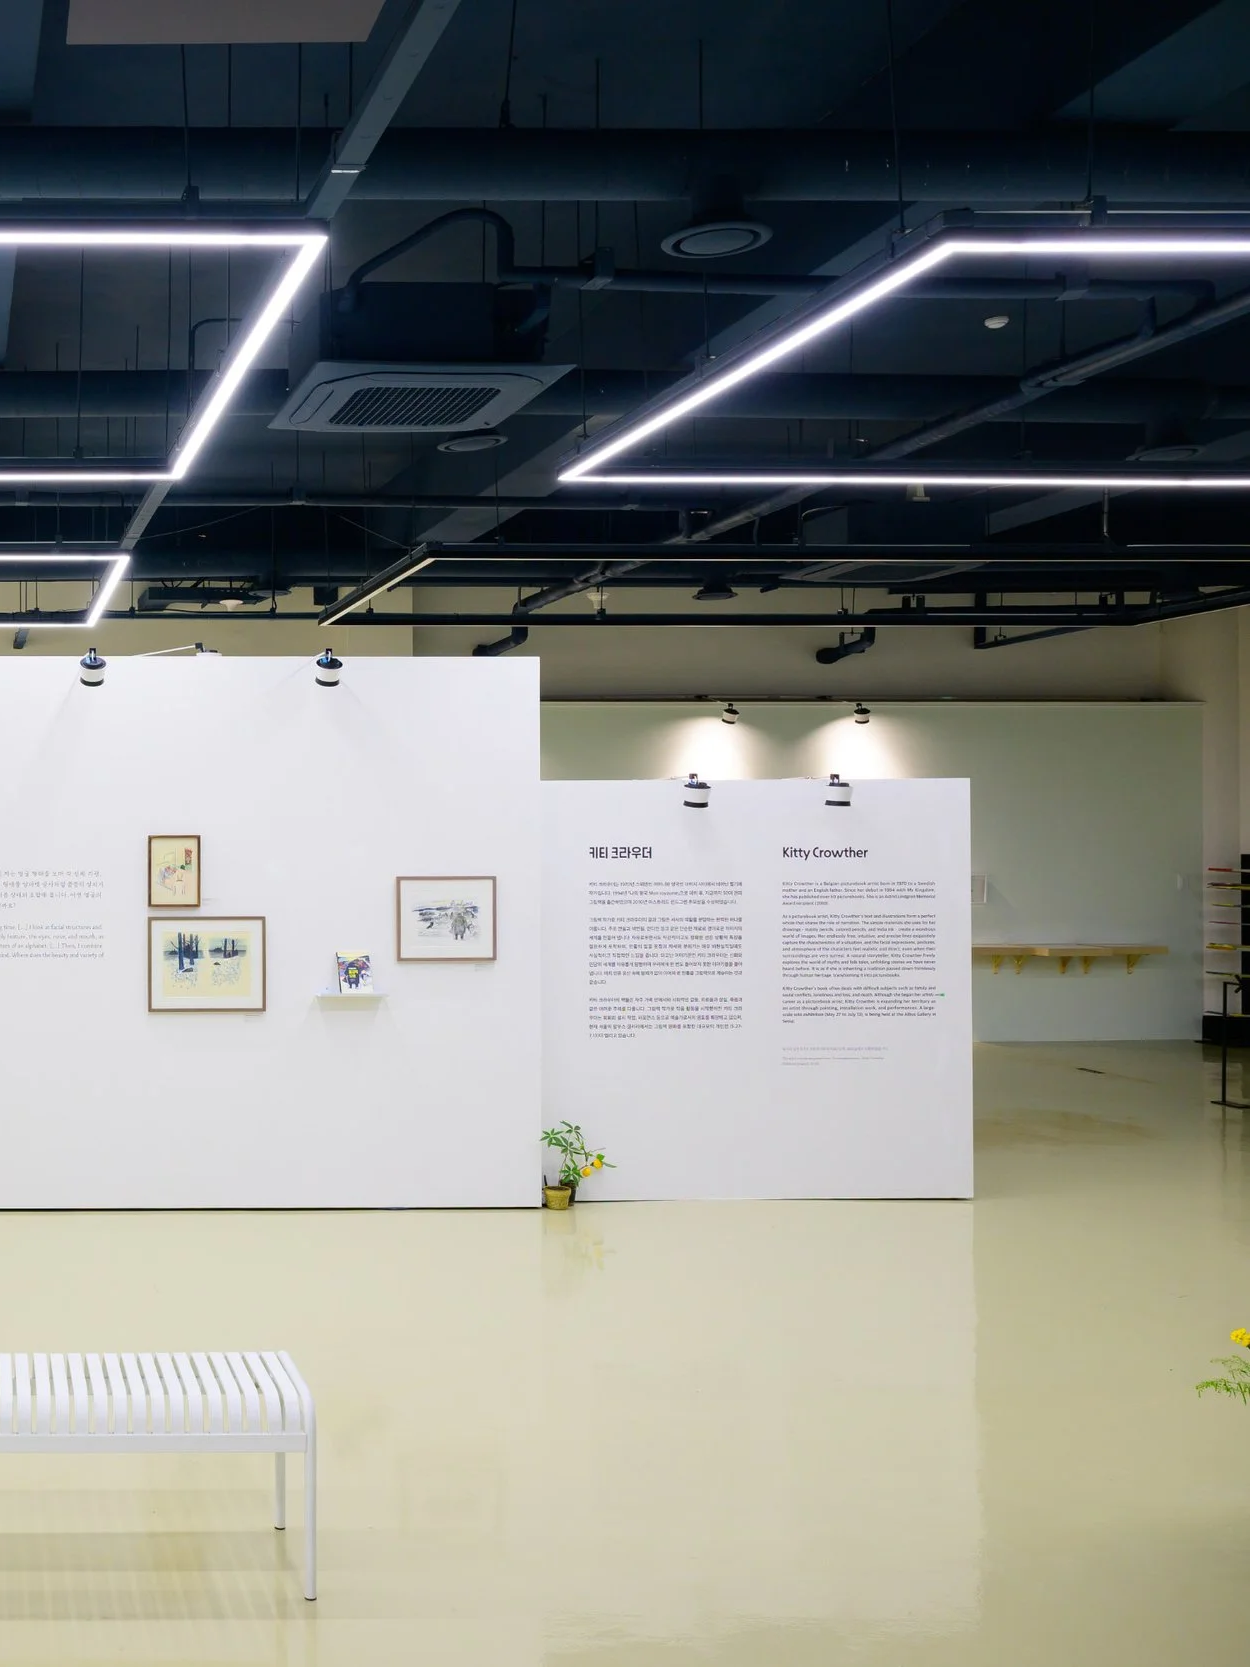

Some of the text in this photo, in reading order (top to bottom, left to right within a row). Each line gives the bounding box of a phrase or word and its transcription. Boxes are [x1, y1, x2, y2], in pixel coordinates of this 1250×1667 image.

[589, 846, 652, 859] 키티 크라우더
[782, 847, 868, 860] Kitty Crowther
